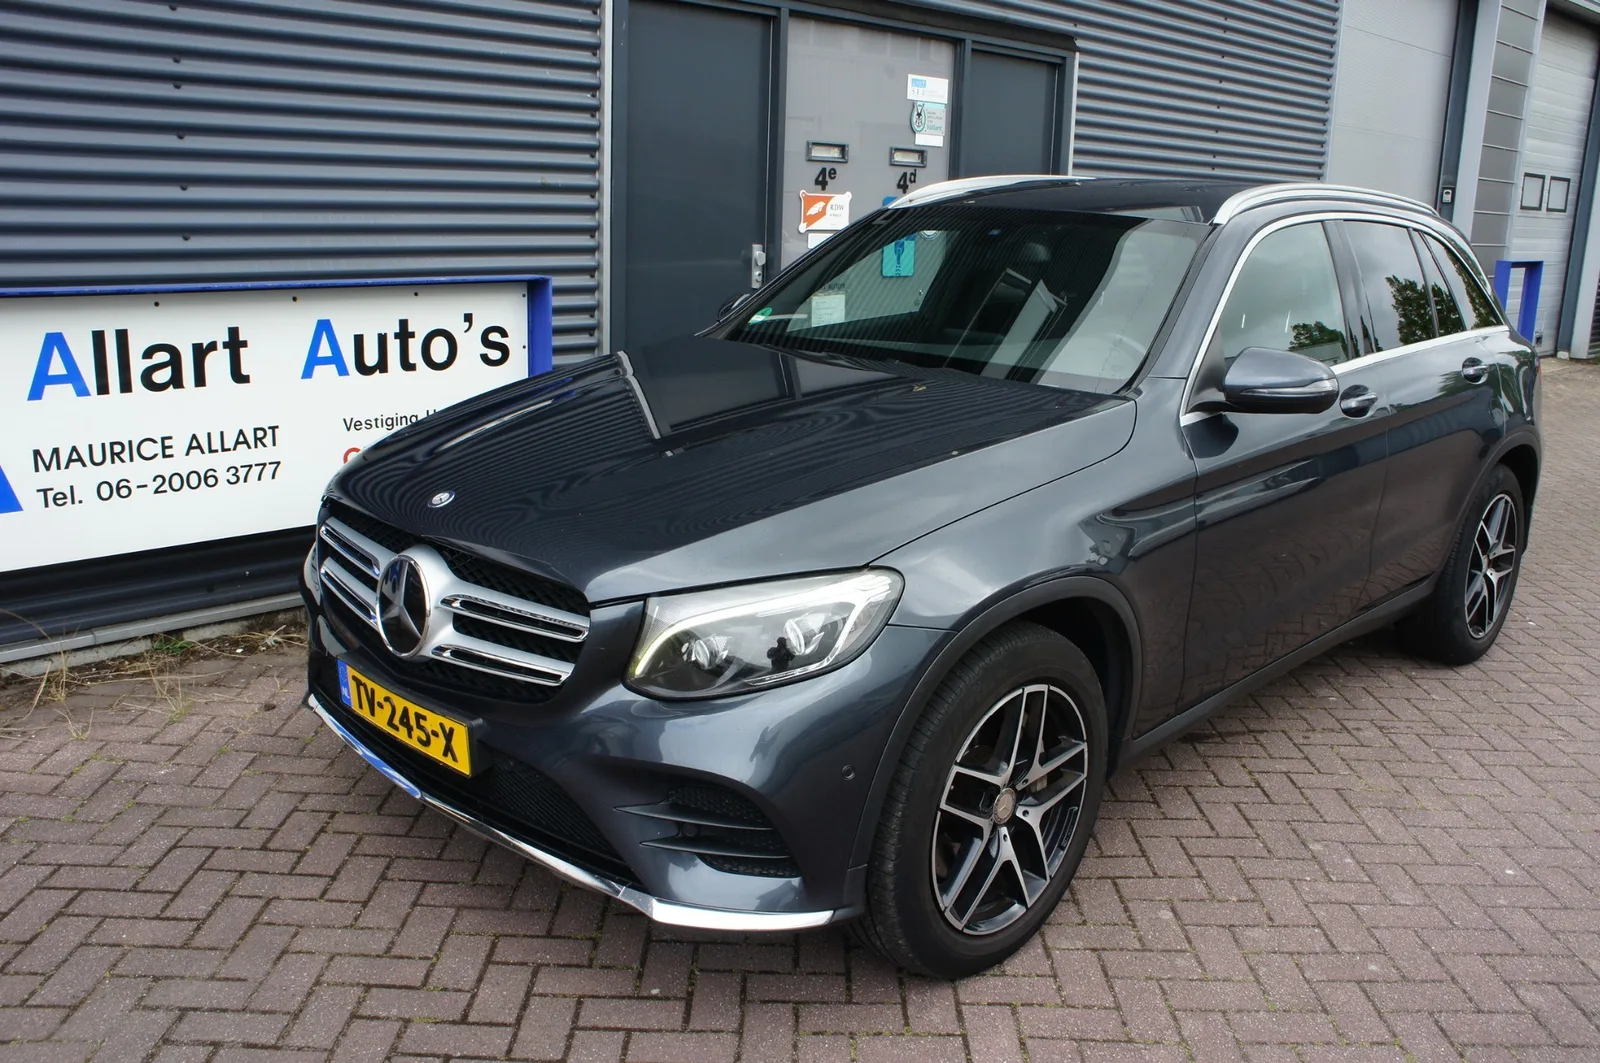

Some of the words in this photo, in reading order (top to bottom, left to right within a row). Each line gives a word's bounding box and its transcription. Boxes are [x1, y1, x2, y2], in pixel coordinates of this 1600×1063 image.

[814, 167, 837, 191] 4e
[896, 169, 917, 194] 4d
[830, 203, 845, 211] RDW
[27, 326, 250, 401] Allart
[301, 313, 510, 379] Auto's
[343, 413, 418, 432] Vestiging
[32, 435, 174, 473] MAURICE
[185, 425, 280, 456] ALLART
[36, 485, 84, 508] Tel.
[226, 461, 282, 485] 3777
[351, 674, 459, 763] TV-245-X
